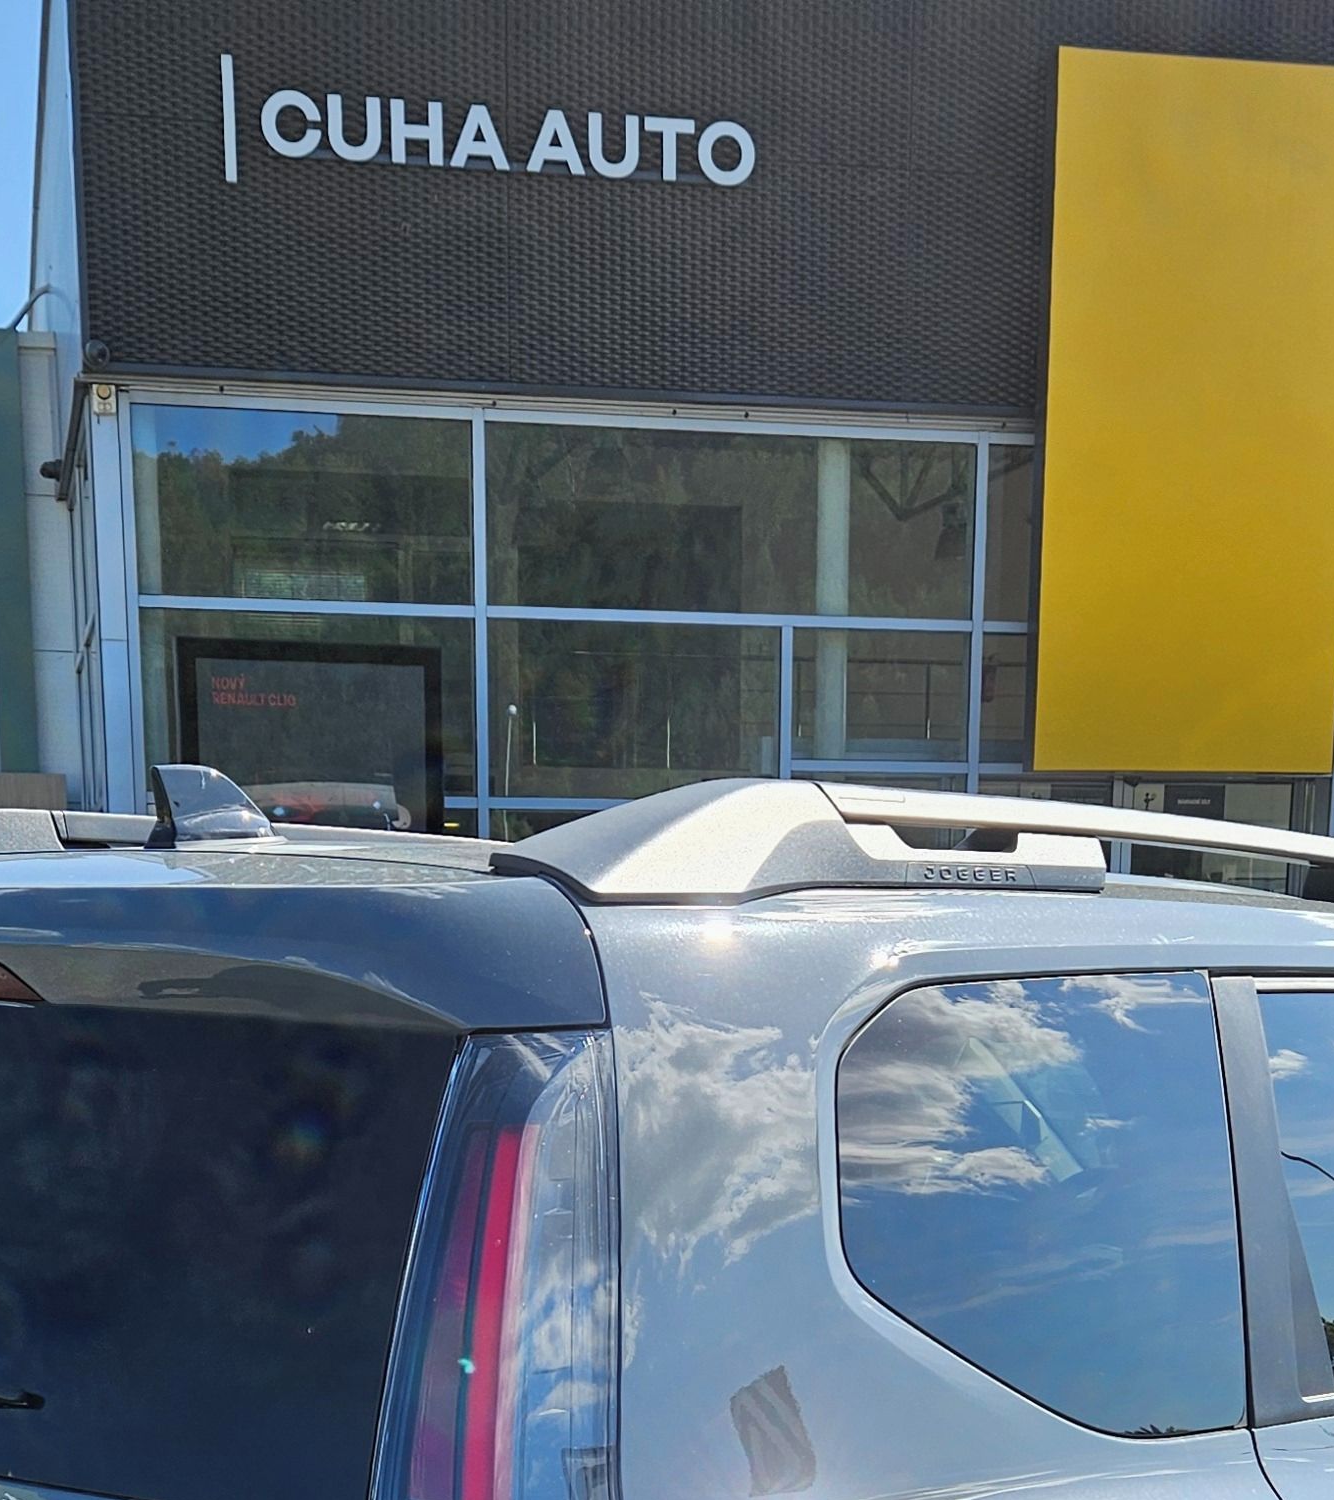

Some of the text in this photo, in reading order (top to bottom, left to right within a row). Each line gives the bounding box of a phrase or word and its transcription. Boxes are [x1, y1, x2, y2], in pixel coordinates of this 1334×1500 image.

[260, 89, 757, 187] CUHA AUTO
[211, 673, 246, 690] NOVÝ
[211, 690, 297, 707] RENAULT CLIO
[923, 863, 1018, 883] JOGGER
